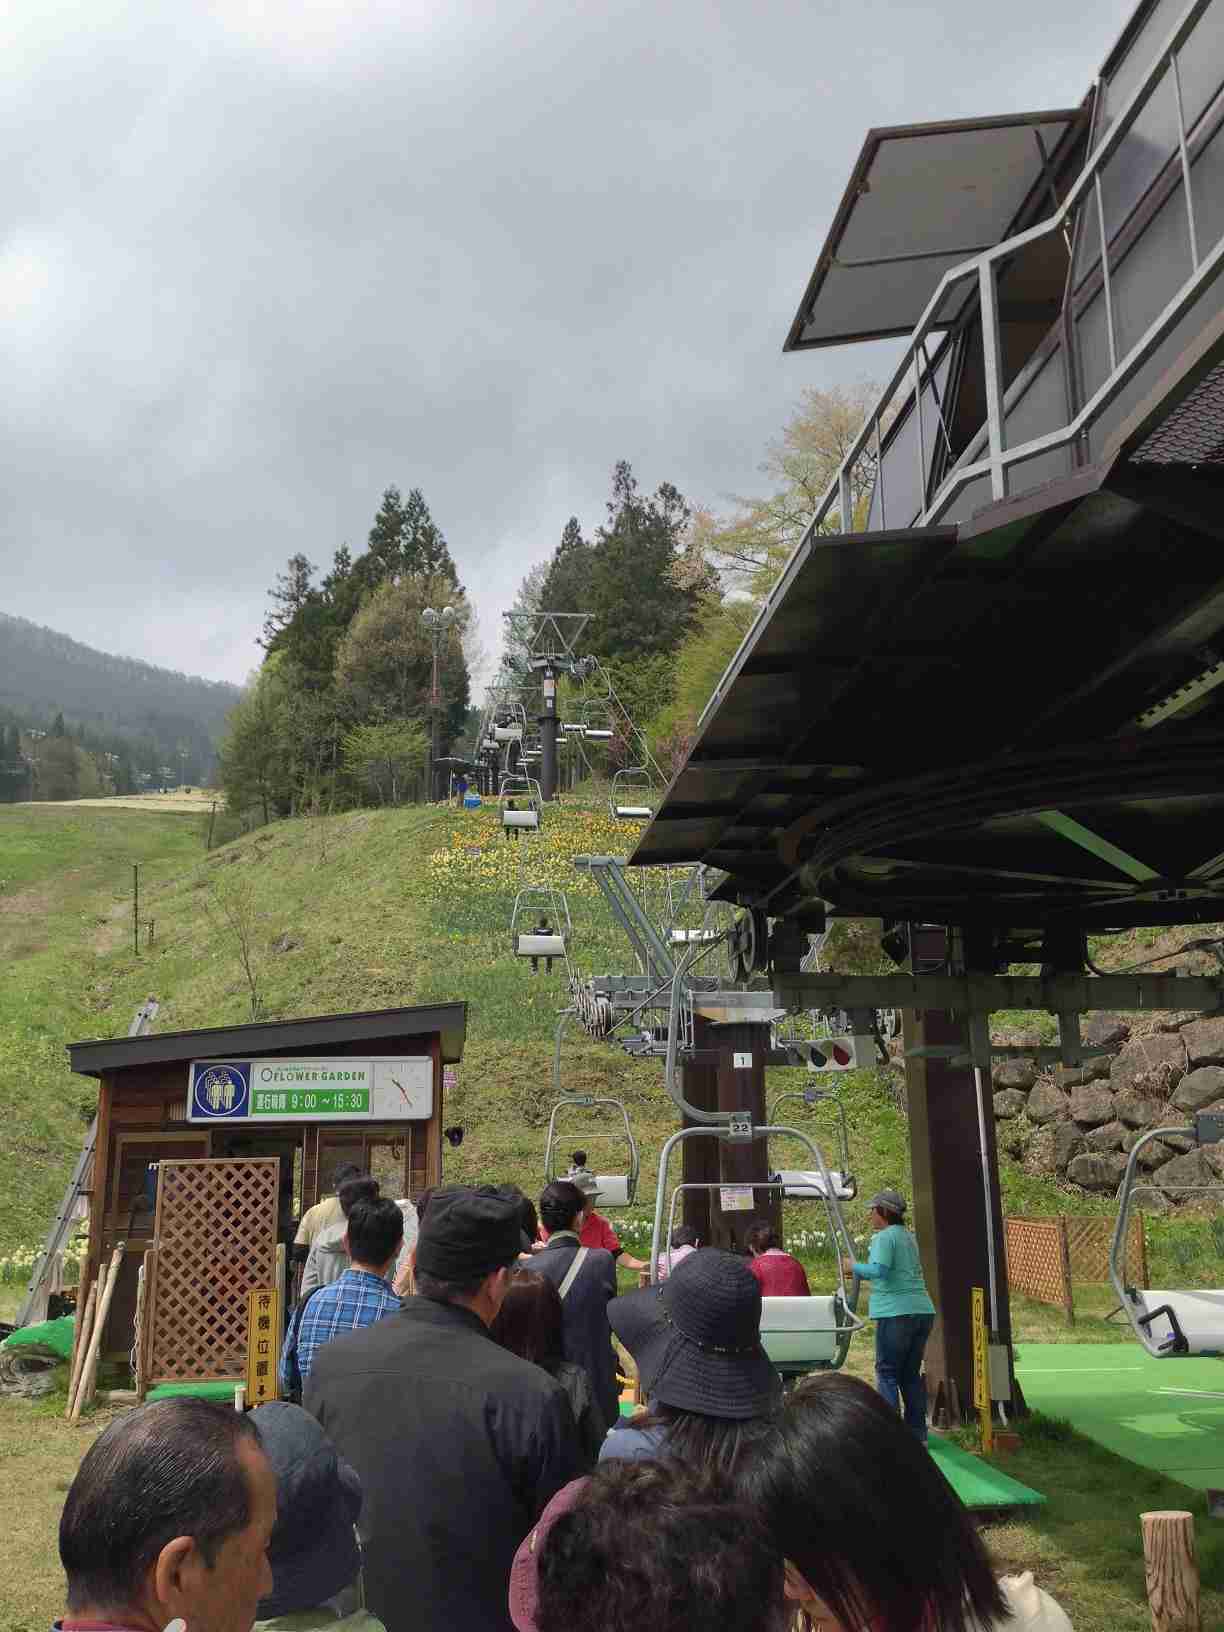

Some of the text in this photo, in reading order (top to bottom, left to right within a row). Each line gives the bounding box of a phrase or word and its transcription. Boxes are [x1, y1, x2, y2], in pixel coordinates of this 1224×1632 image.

[321, 1071, 365, 1081] GARDEN
[291, 1093, 317, 1109] 9:00
[733, 1124, 749, 1132] 22
